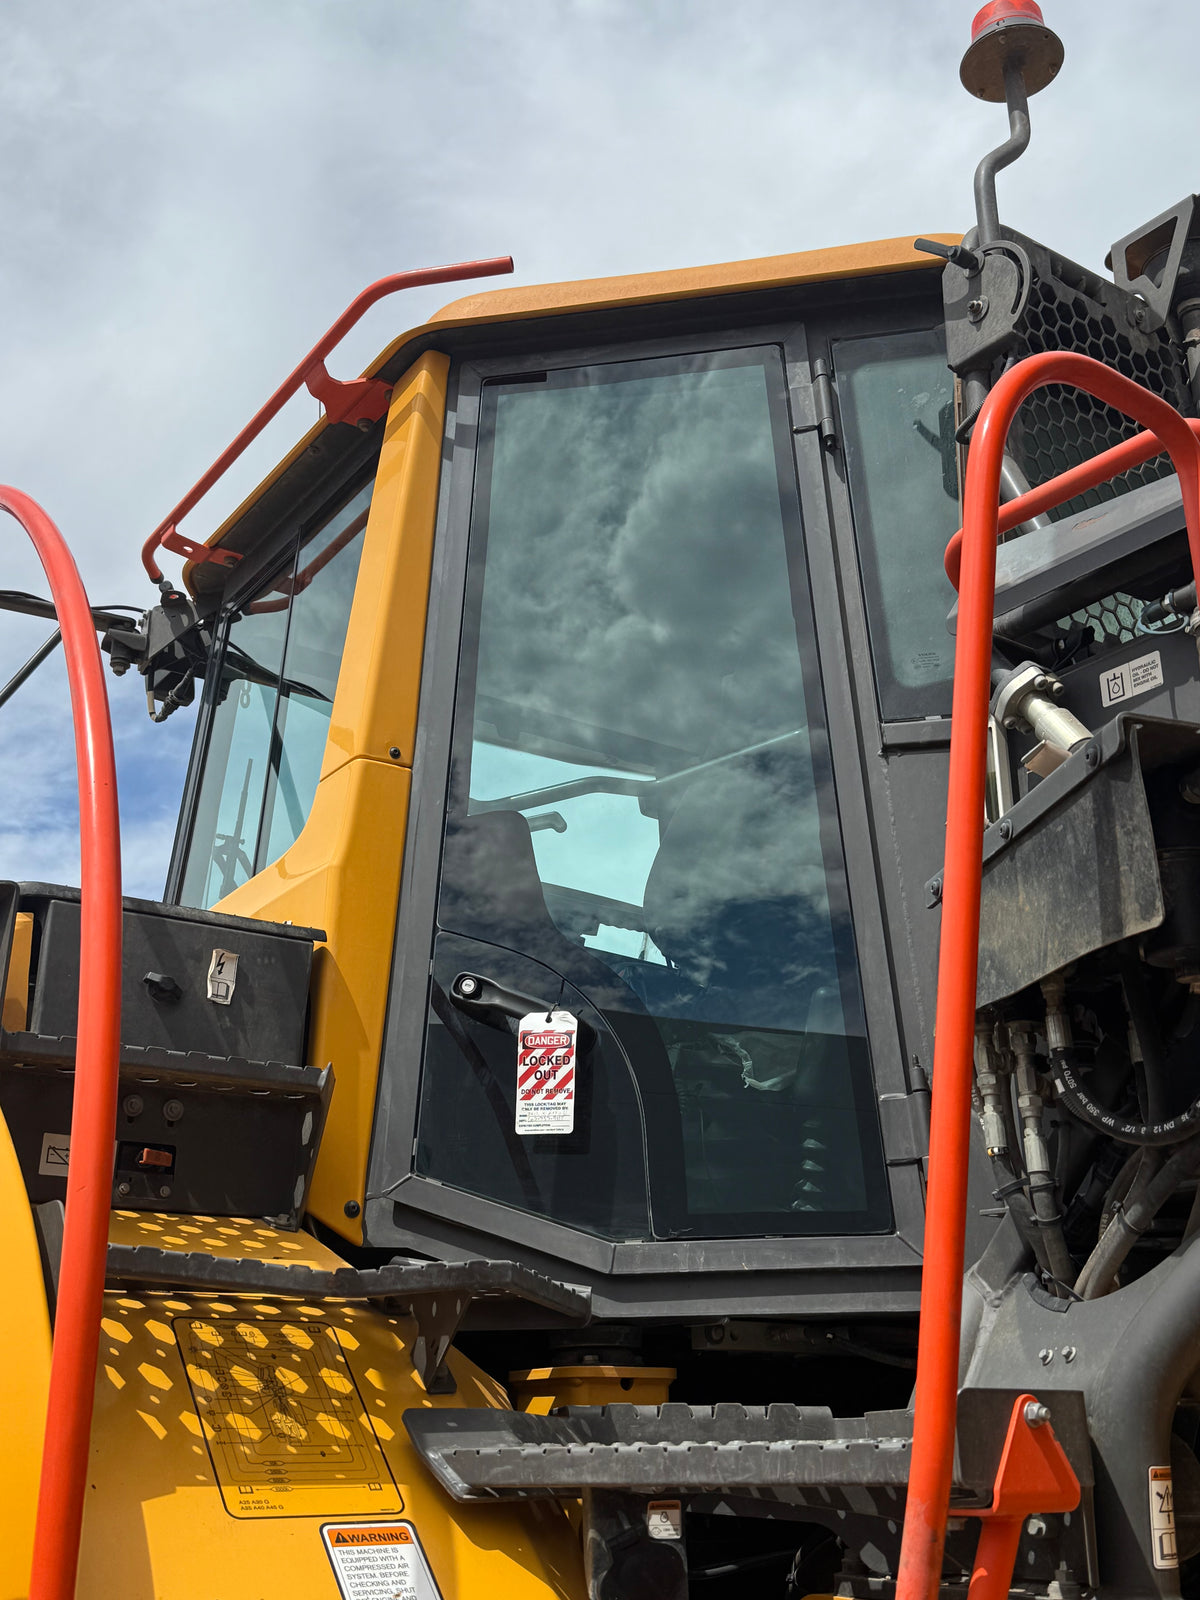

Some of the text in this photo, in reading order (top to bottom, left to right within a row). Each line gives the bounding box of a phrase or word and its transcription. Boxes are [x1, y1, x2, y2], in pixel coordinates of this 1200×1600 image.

[1132, 659, 1156, 672] HYDRAULIC
[1133, 678, 1149, 688] ENGINE
[527, 1036, 567, 1046] DANGER
[522, 1055, 571, 1067] LOCKED
[534, 1069, 559, 1080] OUT
[1063, 1070, 1077, 1089] 5070
[545, 1087, 571, 1095] REMOVE
[1076, 1092, 1089, 1104] bar
[1086, 1103, 1100, 1117] 350
[1101, 1116, 1116, 1127] WP
[1163, 1121, 1175, 1132] DN
[1153, 1126, 1162, 1134] 12
[347, 1532, 409, 1543] WARNING
[341, 1556, 378, 1564] EQUIPPED
[344, 1563, 396, 1572] COMPRESSED
[349, 1580, 390, 1588] CHECKING
[396, 1586, 416, 1594] SHUT
